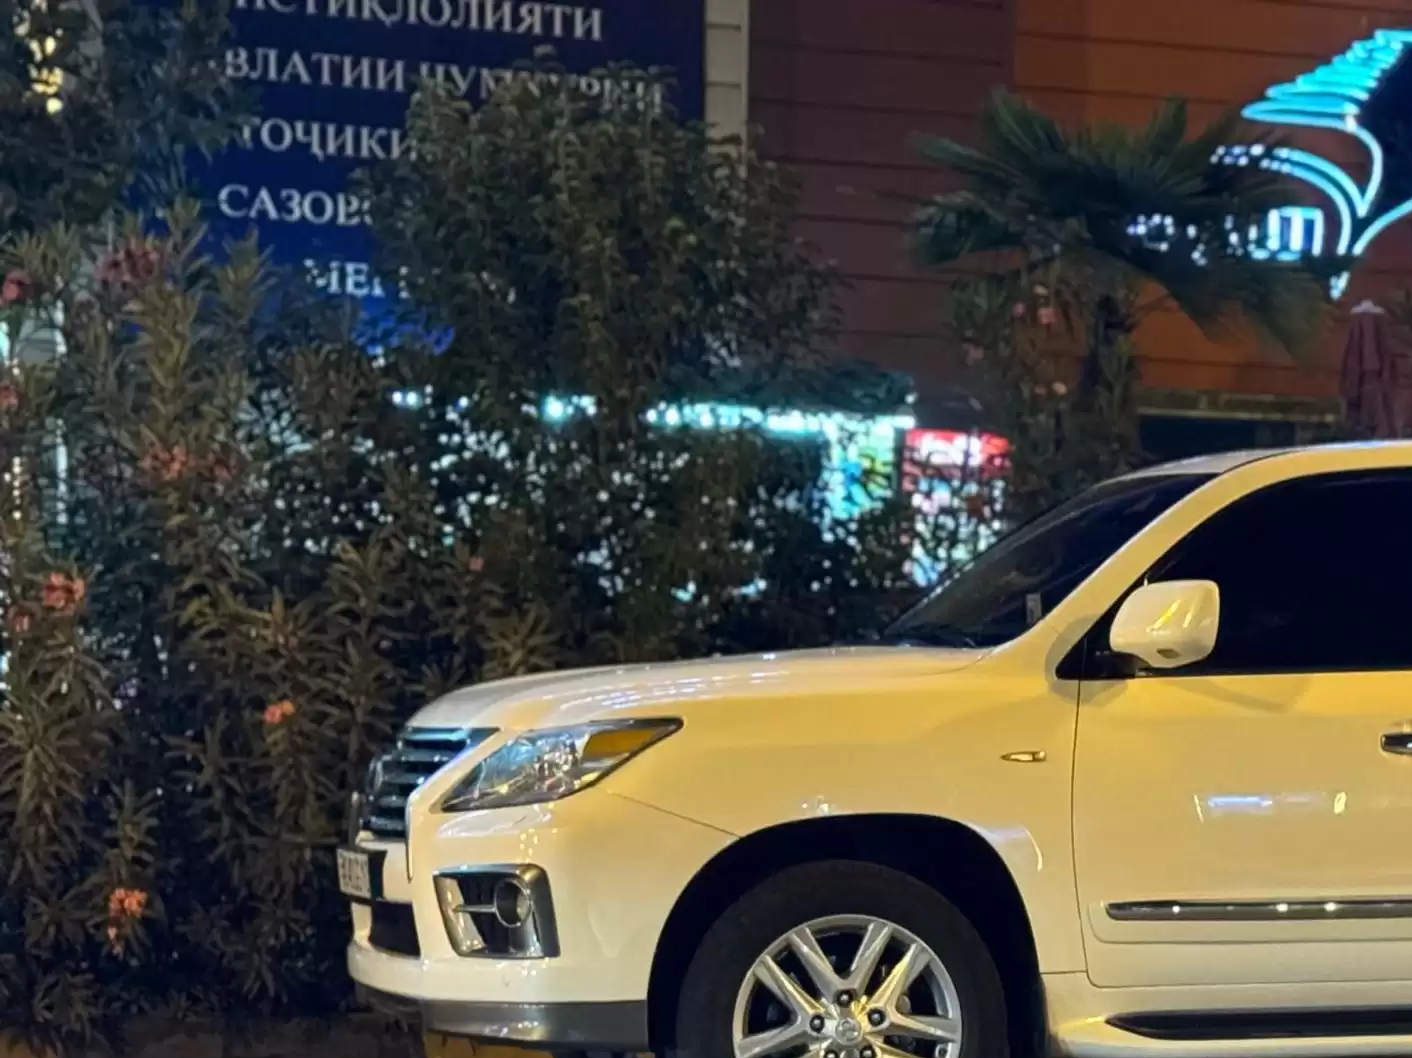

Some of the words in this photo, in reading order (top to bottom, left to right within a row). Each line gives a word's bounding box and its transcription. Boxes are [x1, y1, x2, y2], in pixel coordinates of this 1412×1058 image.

[236, 0, 602, 41] ИҚЛОЛИЯТИ
[225, 46, 405, 92] ВЛАТИИ
[241, 115, 417, 162] ТОҶИКИ
